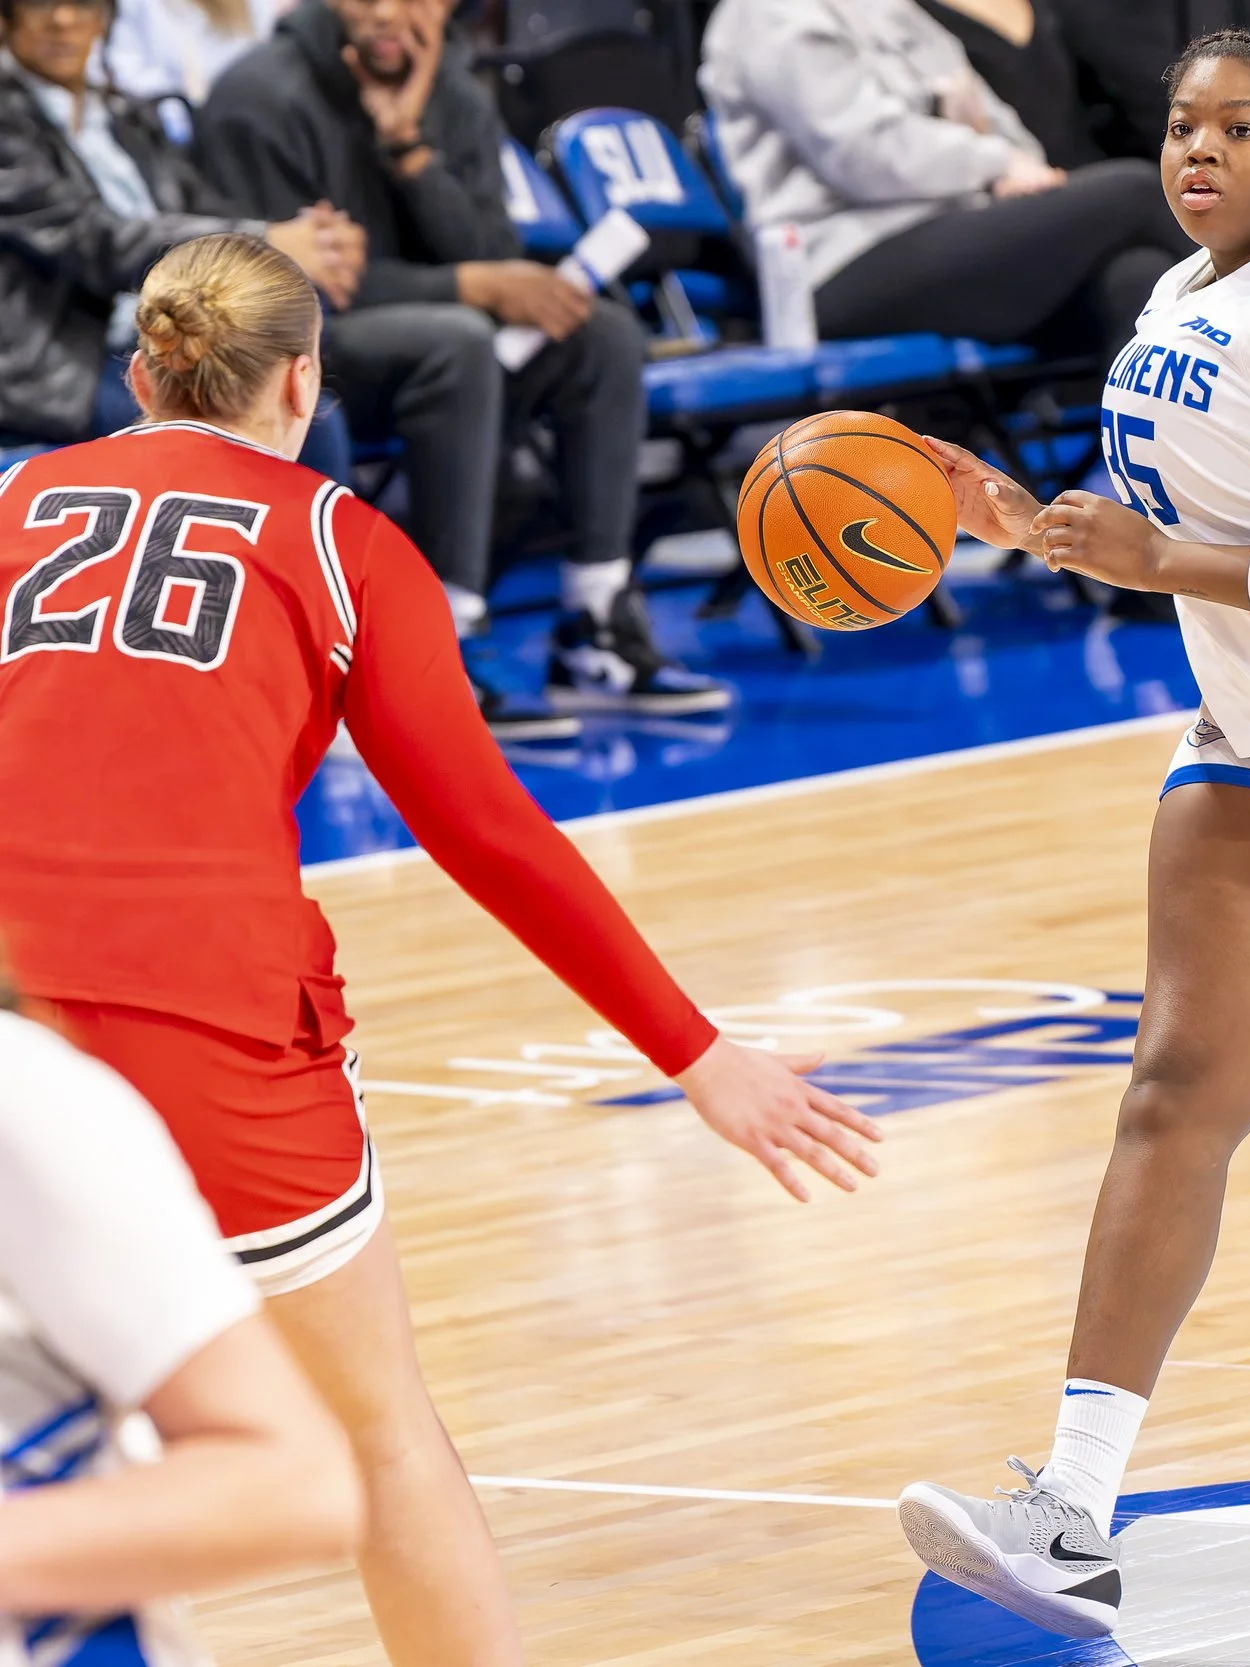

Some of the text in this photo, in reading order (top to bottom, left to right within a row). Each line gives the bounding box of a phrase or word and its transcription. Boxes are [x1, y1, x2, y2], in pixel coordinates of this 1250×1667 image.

[1105, 342, 1220, 414] LIKENS
[1101, 407, 1181, 526] 35
[0, 485, 271, 672] 26
[782, 552, 879, 629] ELITE
